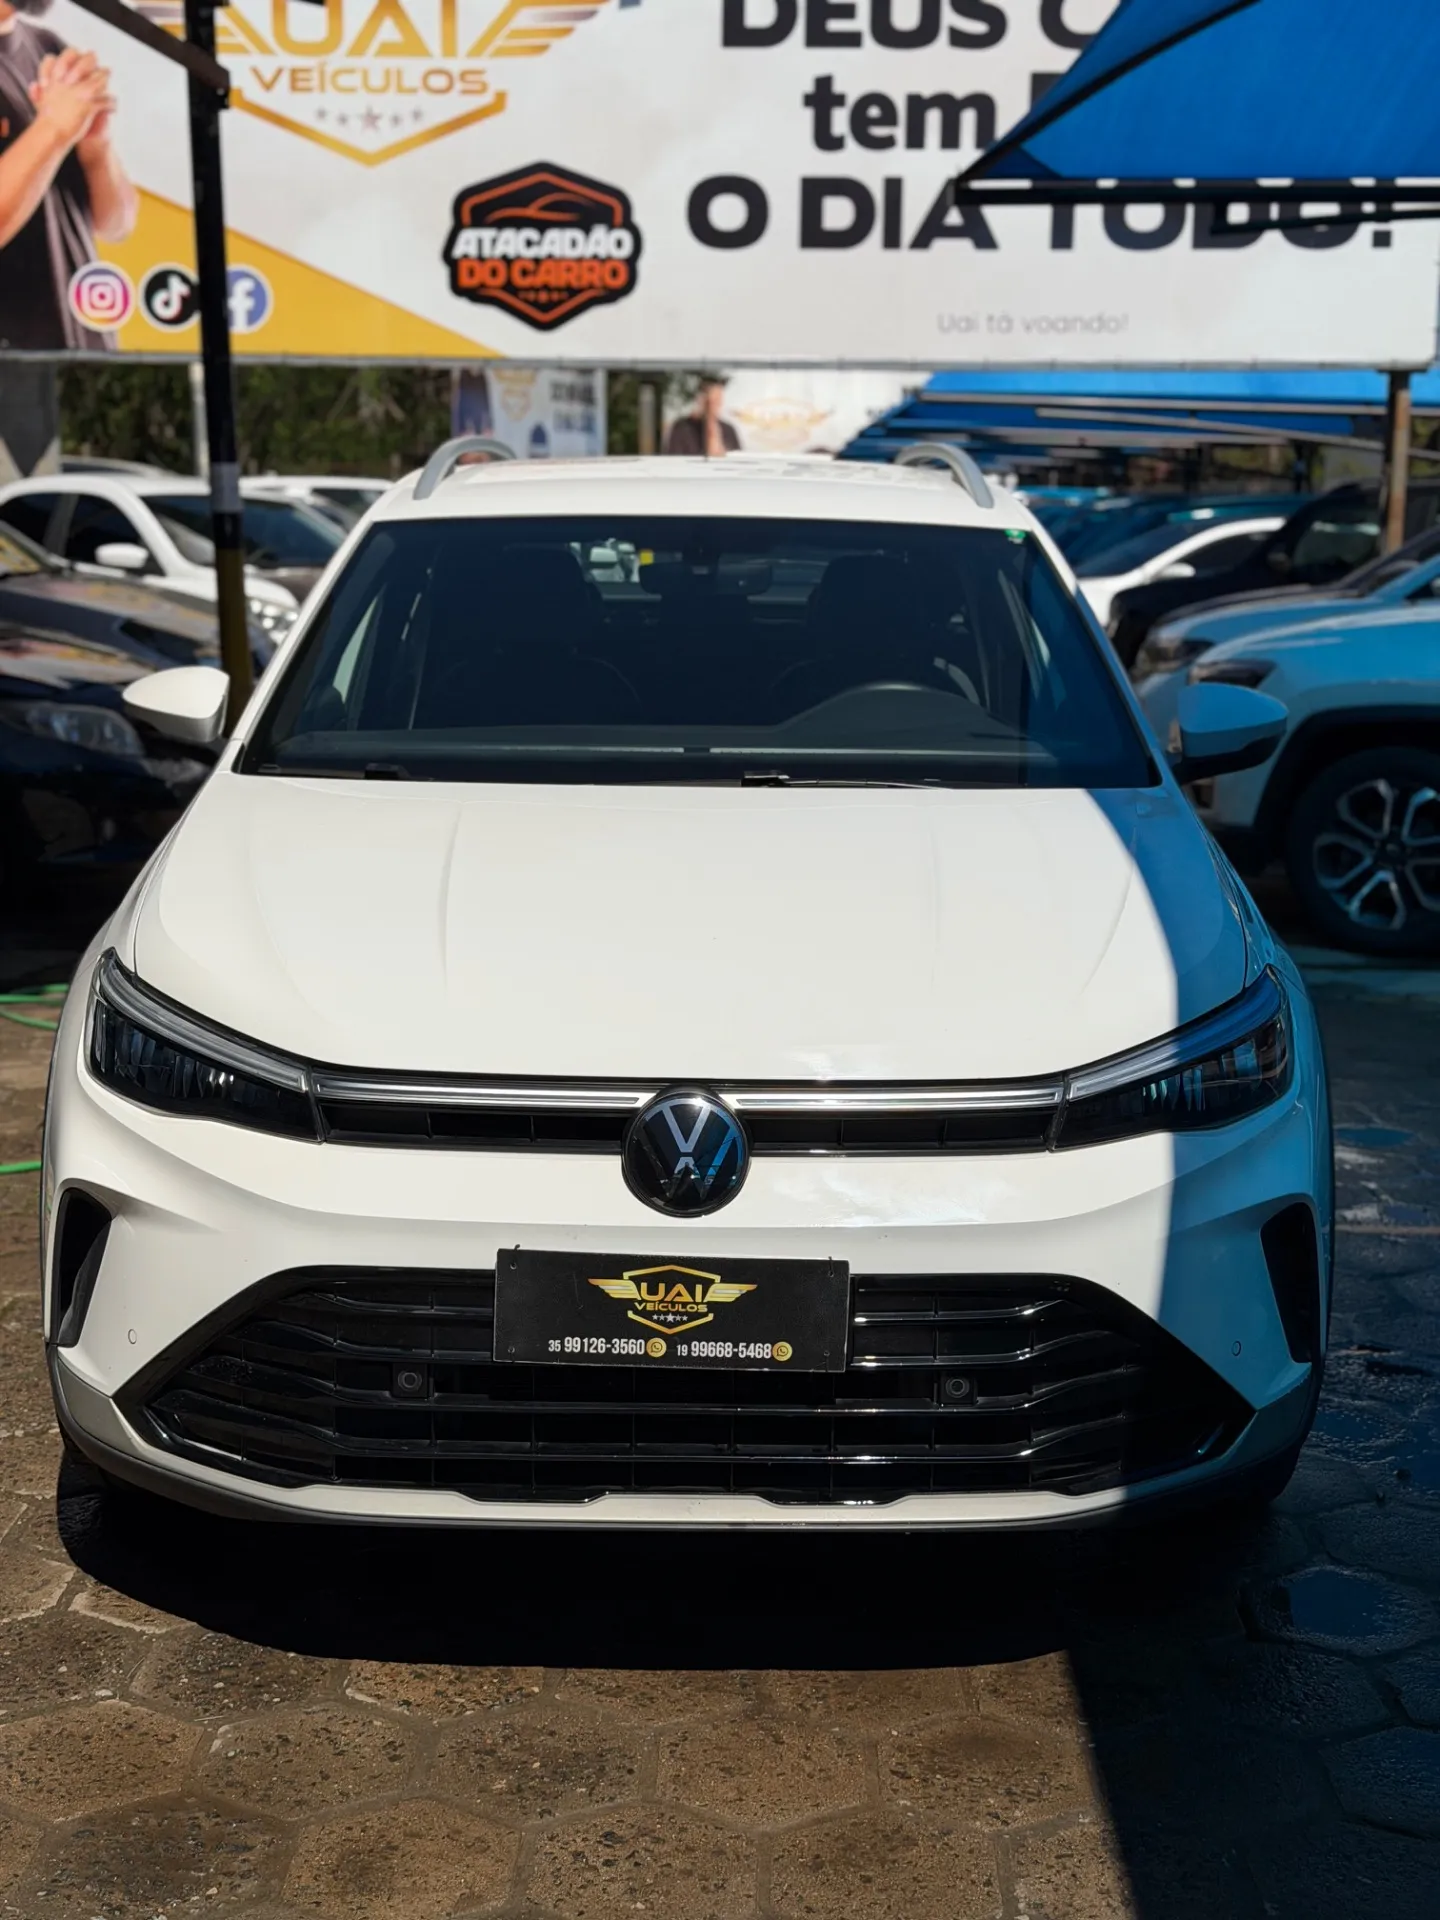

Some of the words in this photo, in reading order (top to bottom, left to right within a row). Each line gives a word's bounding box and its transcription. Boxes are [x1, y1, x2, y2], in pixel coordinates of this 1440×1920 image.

[271, 0, 458, 58] UAI
[720, 0, 1007, 50] DEUS
[250, 63, 490, 95] VEÍCULOS
[803, 73, 997, 152] tem
[686, 175, 769, 250] O
[800, 176, 999, 250] DIA
[451, 223, 634, 260] ATACADÃO
[457, 258, 508, 289] DO
[510, 258, 629, 289] CARRO
[634, 1301, 708, 1313] VEÍCULOS
[640, 1282, 703, 1303] UAI
[548, 1340, 562, 1352] 35
[564, 1337, 646, 1355] 99126-3560
[676, 1344, 688, 1356] 19
[691, 1341, 772, 1359] 99668-5468
